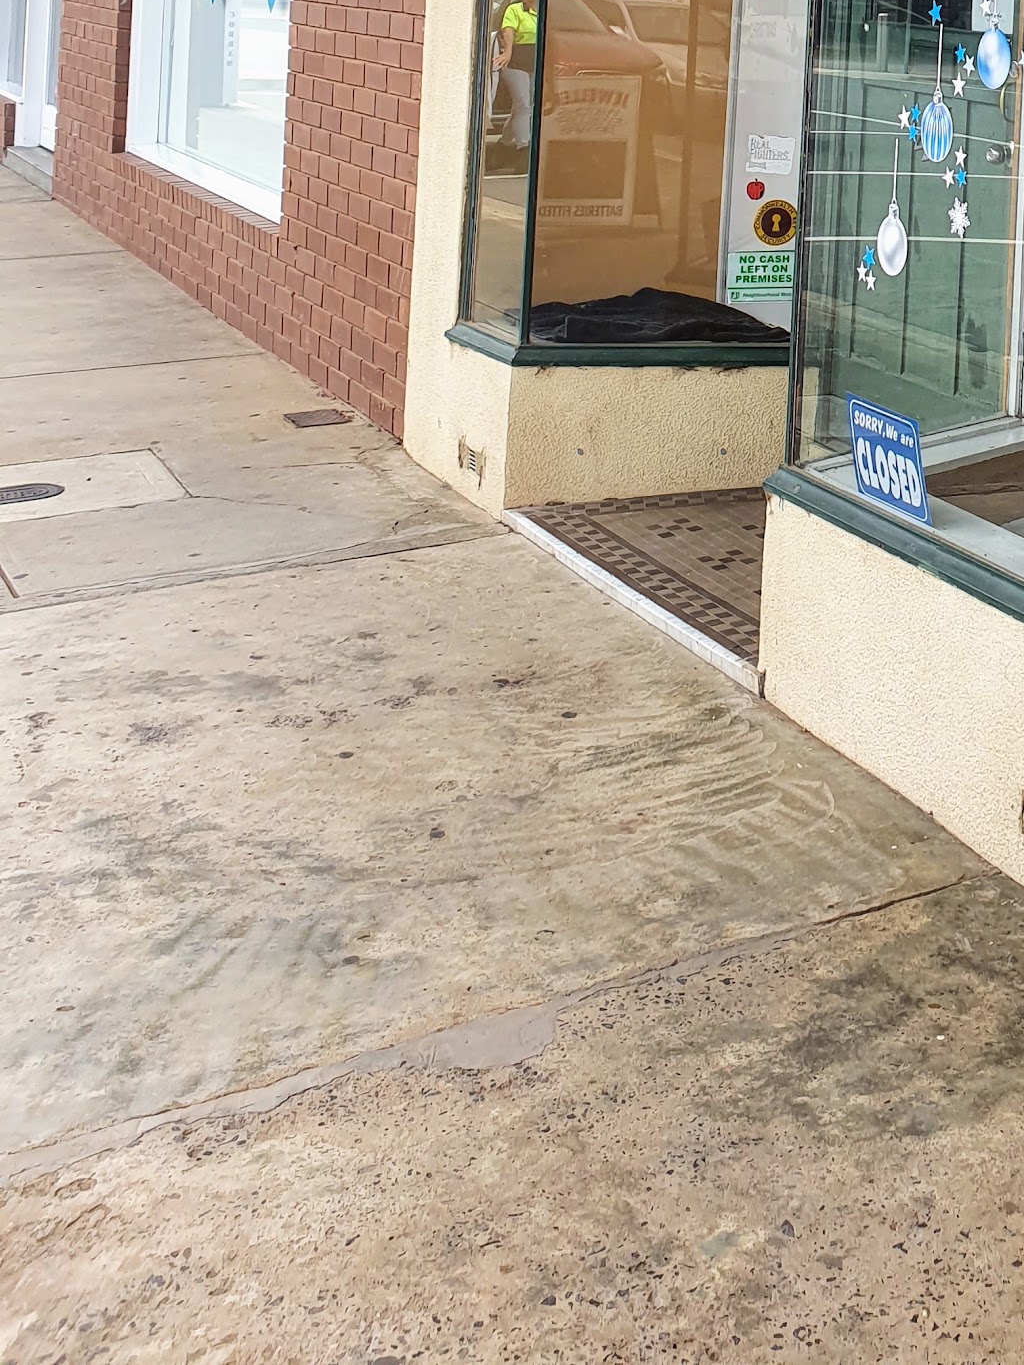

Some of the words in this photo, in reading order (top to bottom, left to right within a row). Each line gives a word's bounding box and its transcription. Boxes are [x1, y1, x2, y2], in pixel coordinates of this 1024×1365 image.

[760, 233, 791, 245] SECURITY
[739, 255, 756, 264] NO
[759, 255, 790, 264] CASH
[740, 265, 769, 274] LEFT
[771, 264, 788, 273] ON
[735, 274, 793, 284] PREMISES
[900, 434, 914, 449] are
[856, 437, 922, 508] CLOSED
